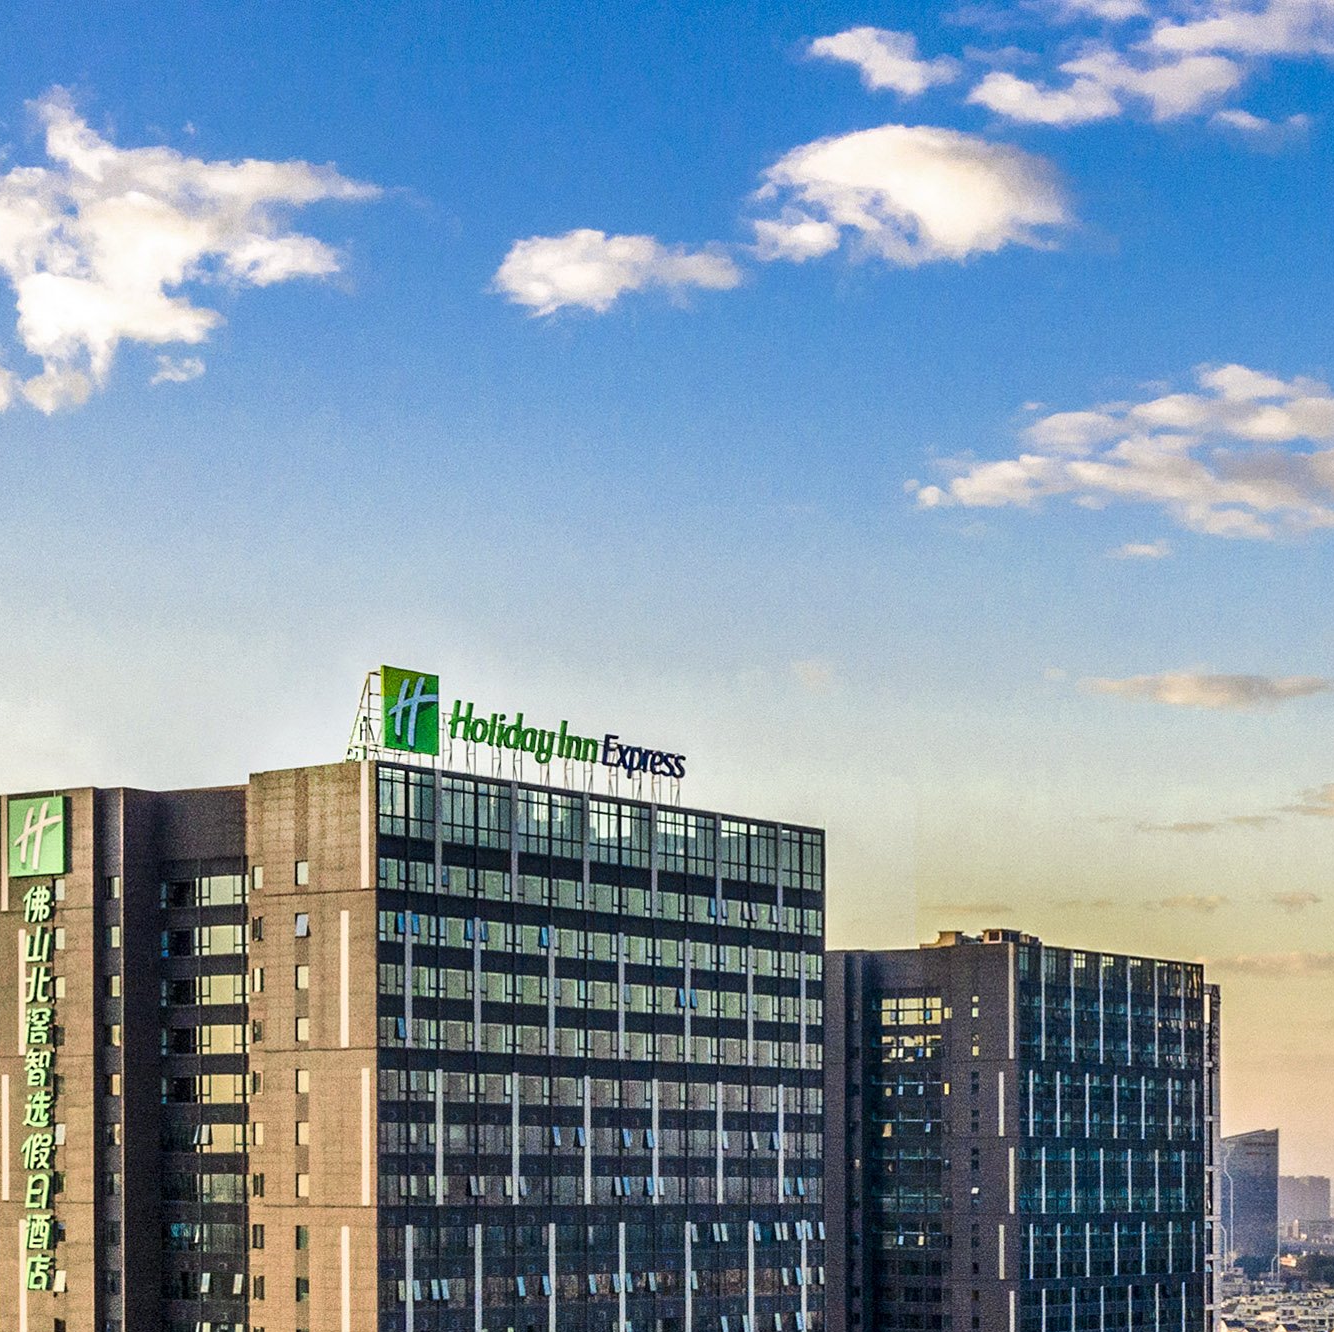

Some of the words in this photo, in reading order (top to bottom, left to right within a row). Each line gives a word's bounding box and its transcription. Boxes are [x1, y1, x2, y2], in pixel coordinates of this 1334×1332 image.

[448, 700, 555, 764] Holiday
[558, 719, 598, 764] Inn
[601, 733, 687, 779] Express
[21, 885, 52, 1291] 佛山北滘智选假日酒店
